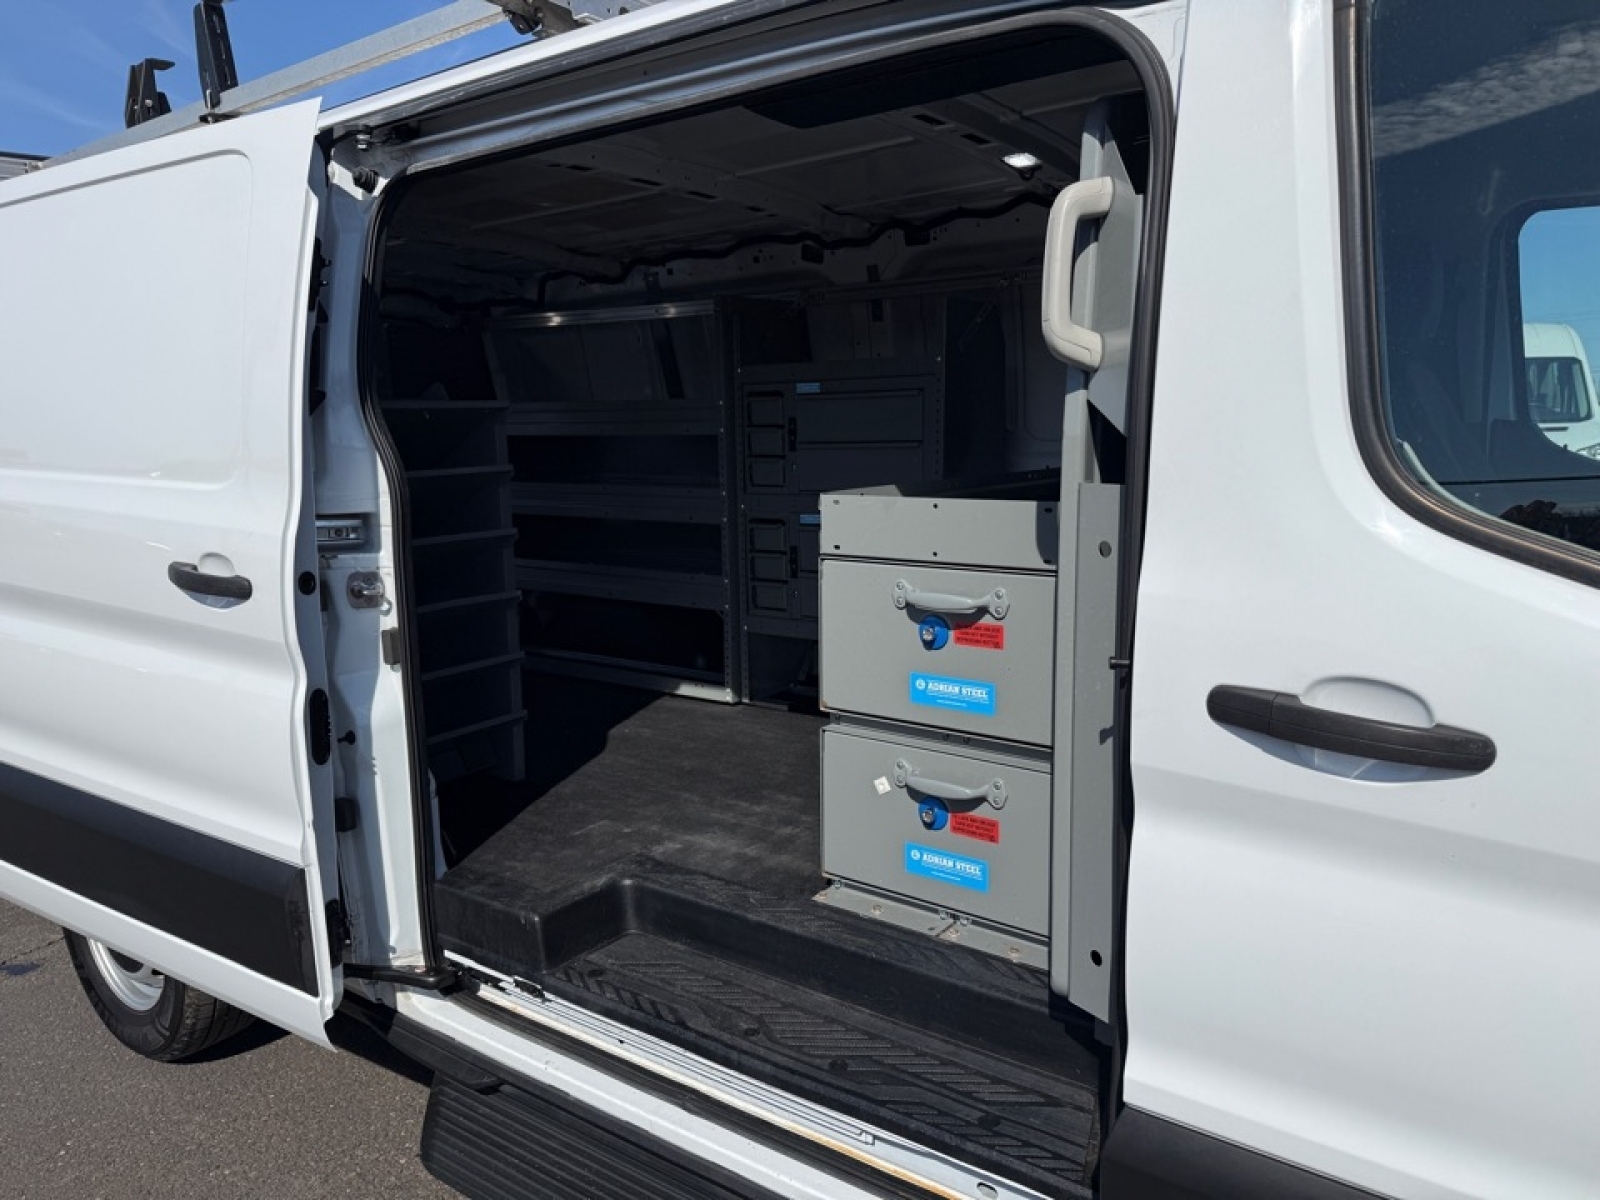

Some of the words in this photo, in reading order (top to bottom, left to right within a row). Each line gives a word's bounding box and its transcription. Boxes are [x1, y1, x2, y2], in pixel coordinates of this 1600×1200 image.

[928, 682, 960, 694] ADRIAN
[961, 687, 987, 698] STEEL
[922, 854, 954, 868] ADRIAN
[956, 862, 982, 875] STEEL
